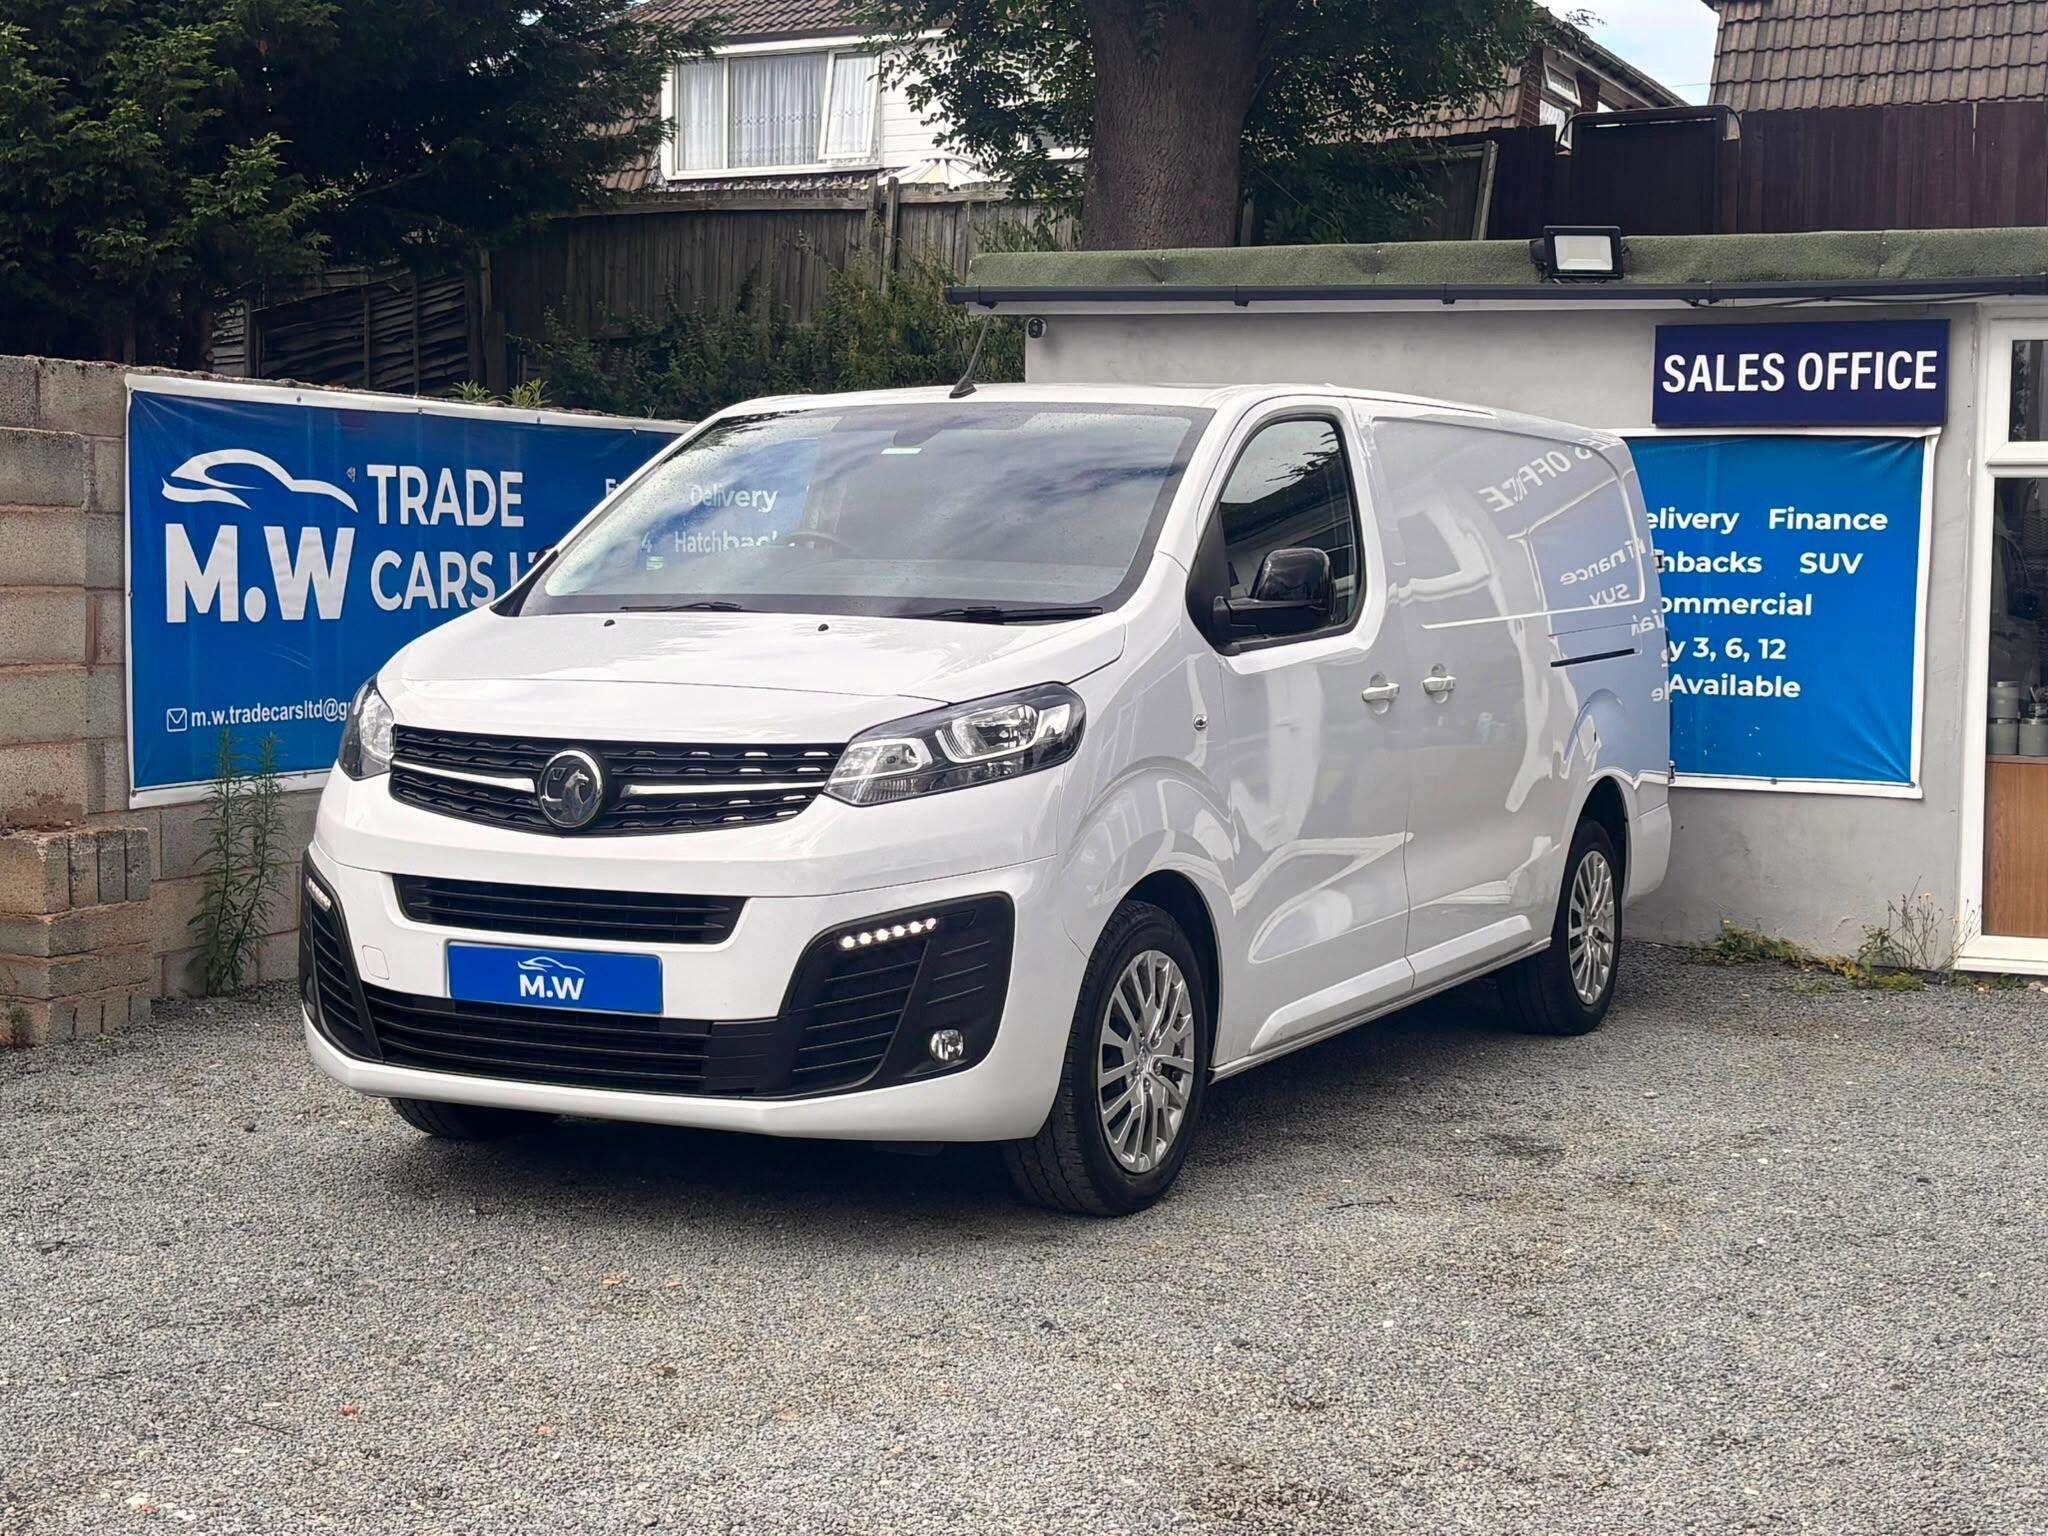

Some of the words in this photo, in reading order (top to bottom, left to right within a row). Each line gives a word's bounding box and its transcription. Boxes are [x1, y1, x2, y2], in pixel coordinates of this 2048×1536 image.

[1662, 353, 1785, 393] SALES
[1798, 350, 1938, 391] OFFICE
[366, 464, 525, 528] TRADE
[690, 484, 779, 514] Delivery
[1646, 506, 1739, 535] elivery
[1769, 506, 1888, 531] Finance
[165, 522, 356, 624] M.W
[1799, 552, 1864, 575] SUV
[370, 551, 496, 611] CARS
[1660, 592, 1813, 616] ommercial
[1692, 637, 1717, 662] 3,
[1724, 637, 1751, 663] 6,
[1758, 638, 1787, 660] 12
[1669, 673, 1801, 698] Available
[191, 698, 352, 727] m.w.tradecarsltd@g
[519, 974, 585, 1000] M.W
